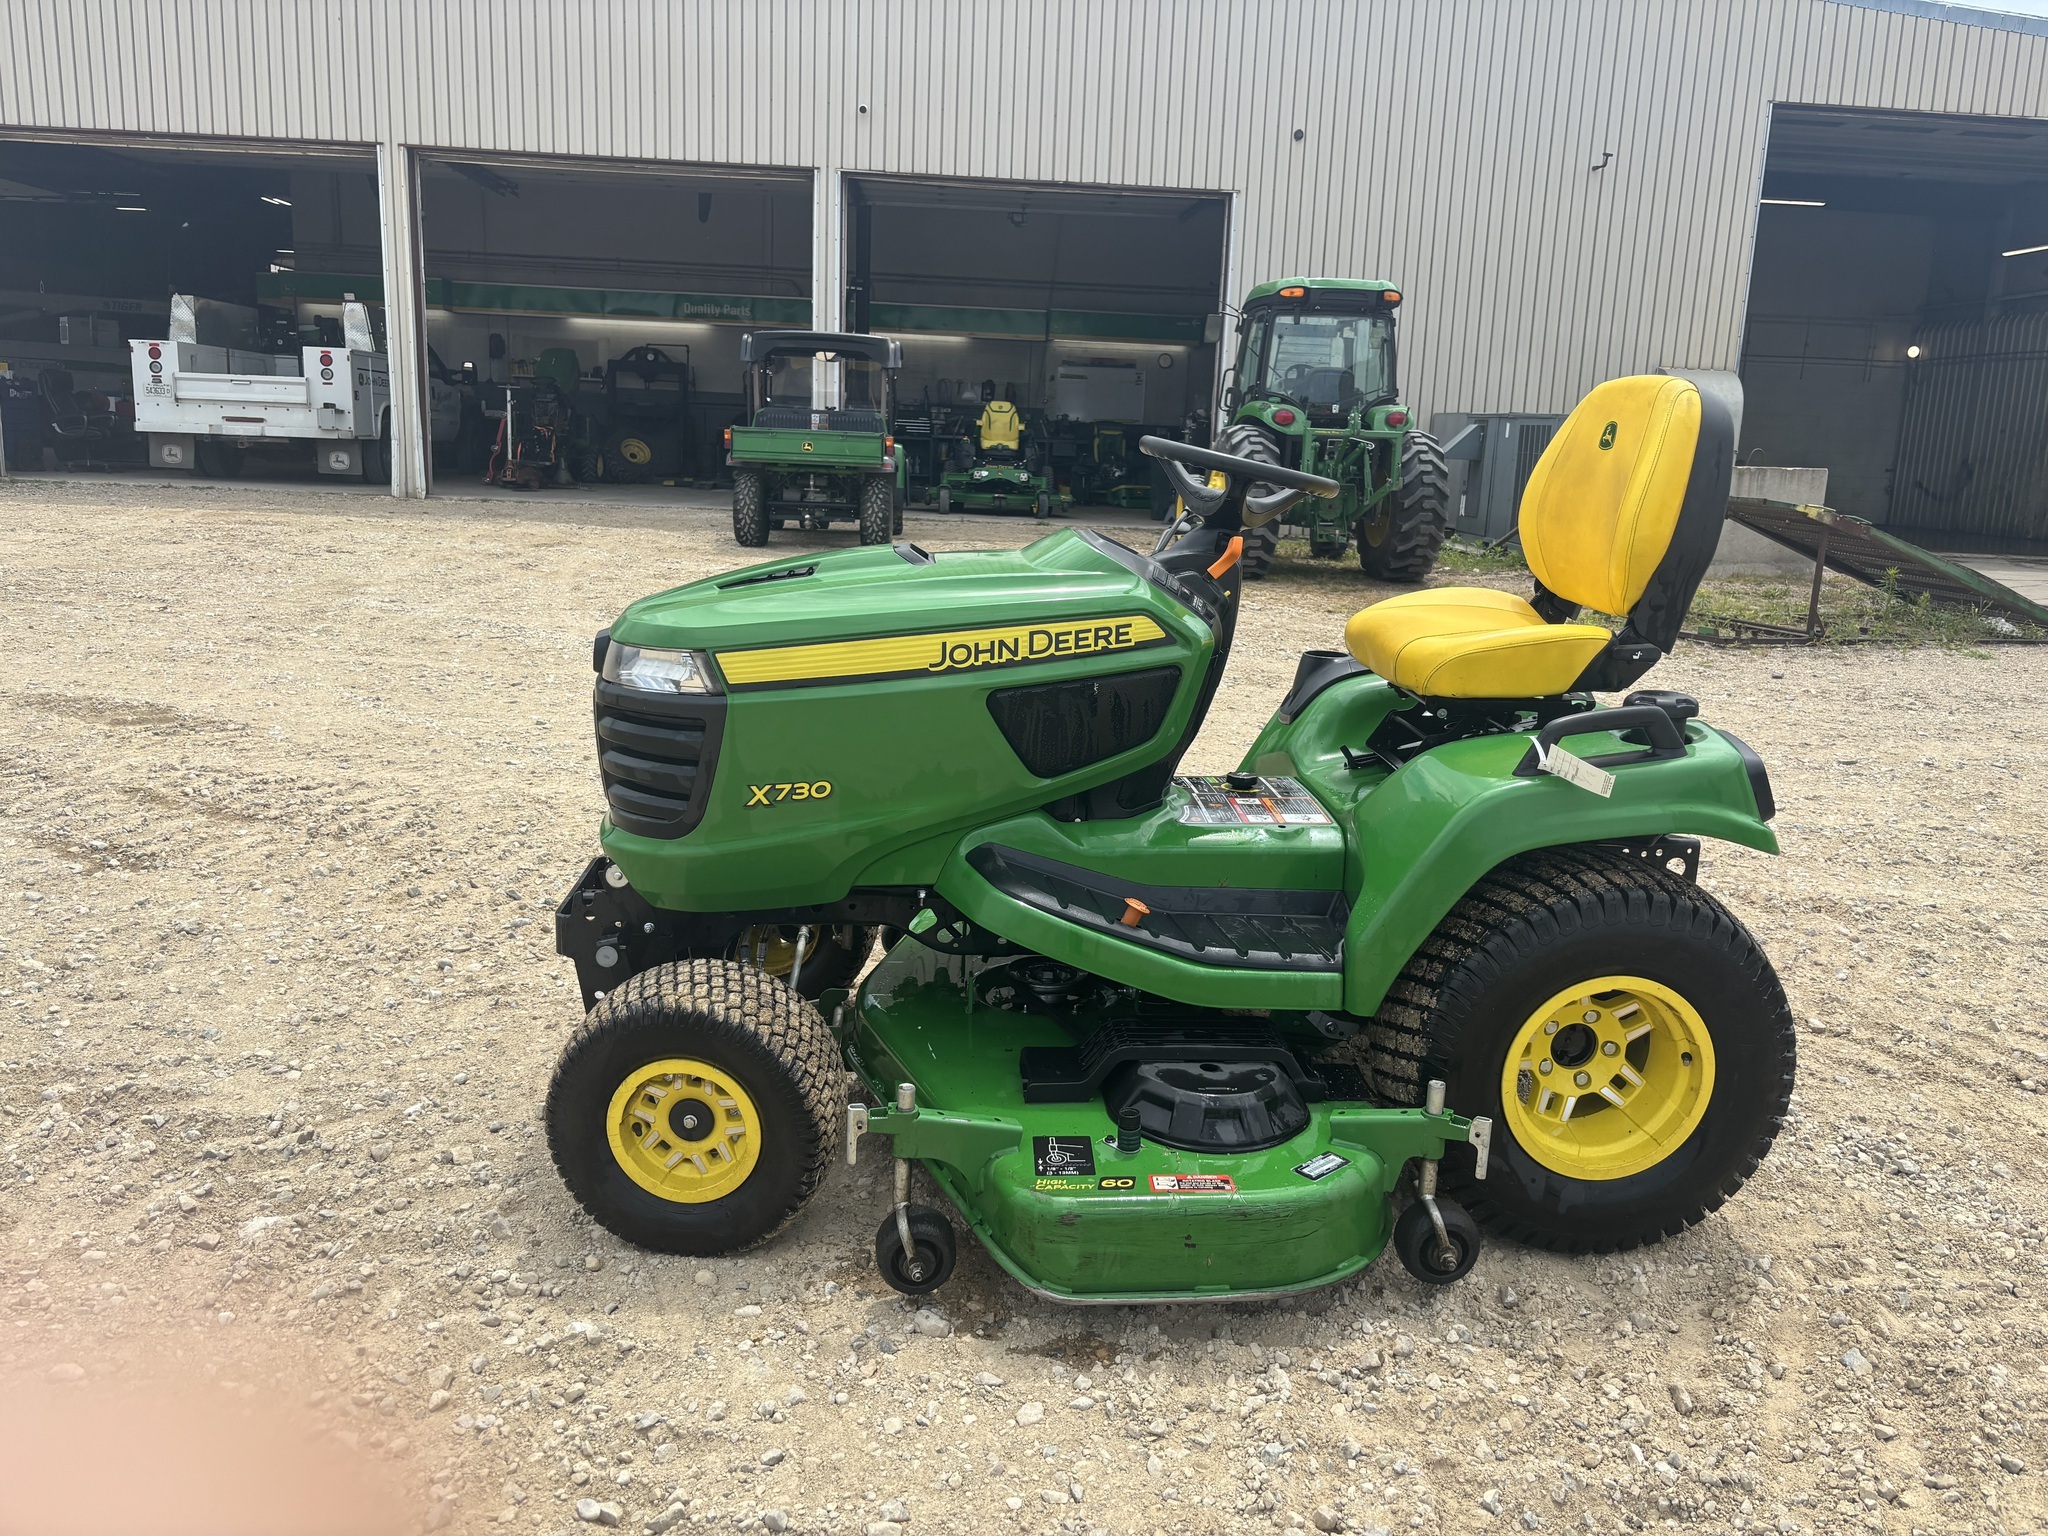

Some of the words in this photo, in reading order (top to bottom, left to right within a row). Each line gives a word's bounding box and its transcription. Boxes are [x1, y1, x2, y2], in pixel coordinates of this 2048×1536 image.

[683, 302, 720, 317] Quality
[723, 304, 751, 316] Parts
[364, 375, 379, 387] JOHN
[145, 386, 166, 395] 543633
[928, 637, 1020, 670] JOHN
[1028, 623, 1133, 656] DEERE
[744, 780, 832, 806] X730
[1101, 1179, 1134, 1188] 60
